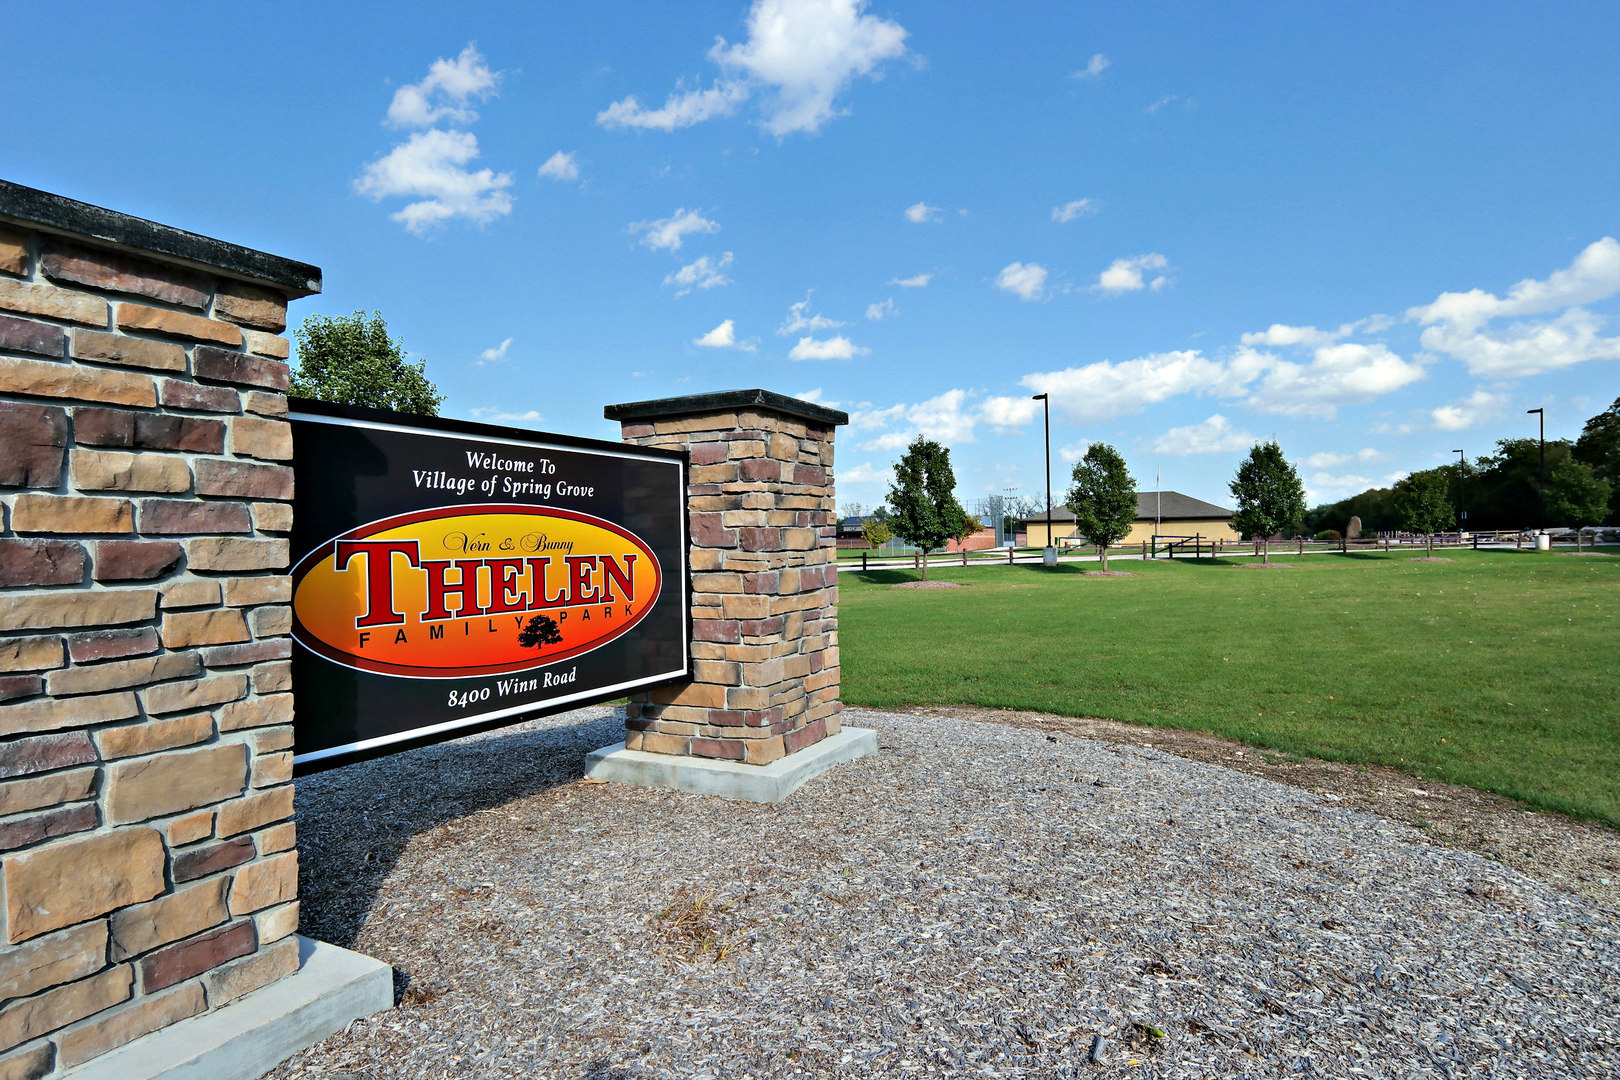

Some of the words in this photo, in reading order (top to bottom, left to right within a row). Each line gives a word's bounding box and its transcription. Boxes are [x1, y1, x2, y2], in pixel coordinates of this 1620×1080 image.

[466, 451, 534, 474] Welcome
[540, 458, 556, 475] To
[412, 470, 476, 496] Village
[481, 476, 497, 494] of
[502, 476, 552, 499] Spring
[556, 481, 594, 498] Grove
[443, 532, 490, 553] Vern
[499, 537, 515, 551] &
[520, 532, 573, 555] Bunny
[334, 539, 637, 630] THELEN
[360, 616, 523, 648] FAMILY
[559, 604, 633, 625] PARK
[447, 688, 490, 708] 8400
[496, 678, 537, 696] Winn
[544, 667, 577, 688] Road
